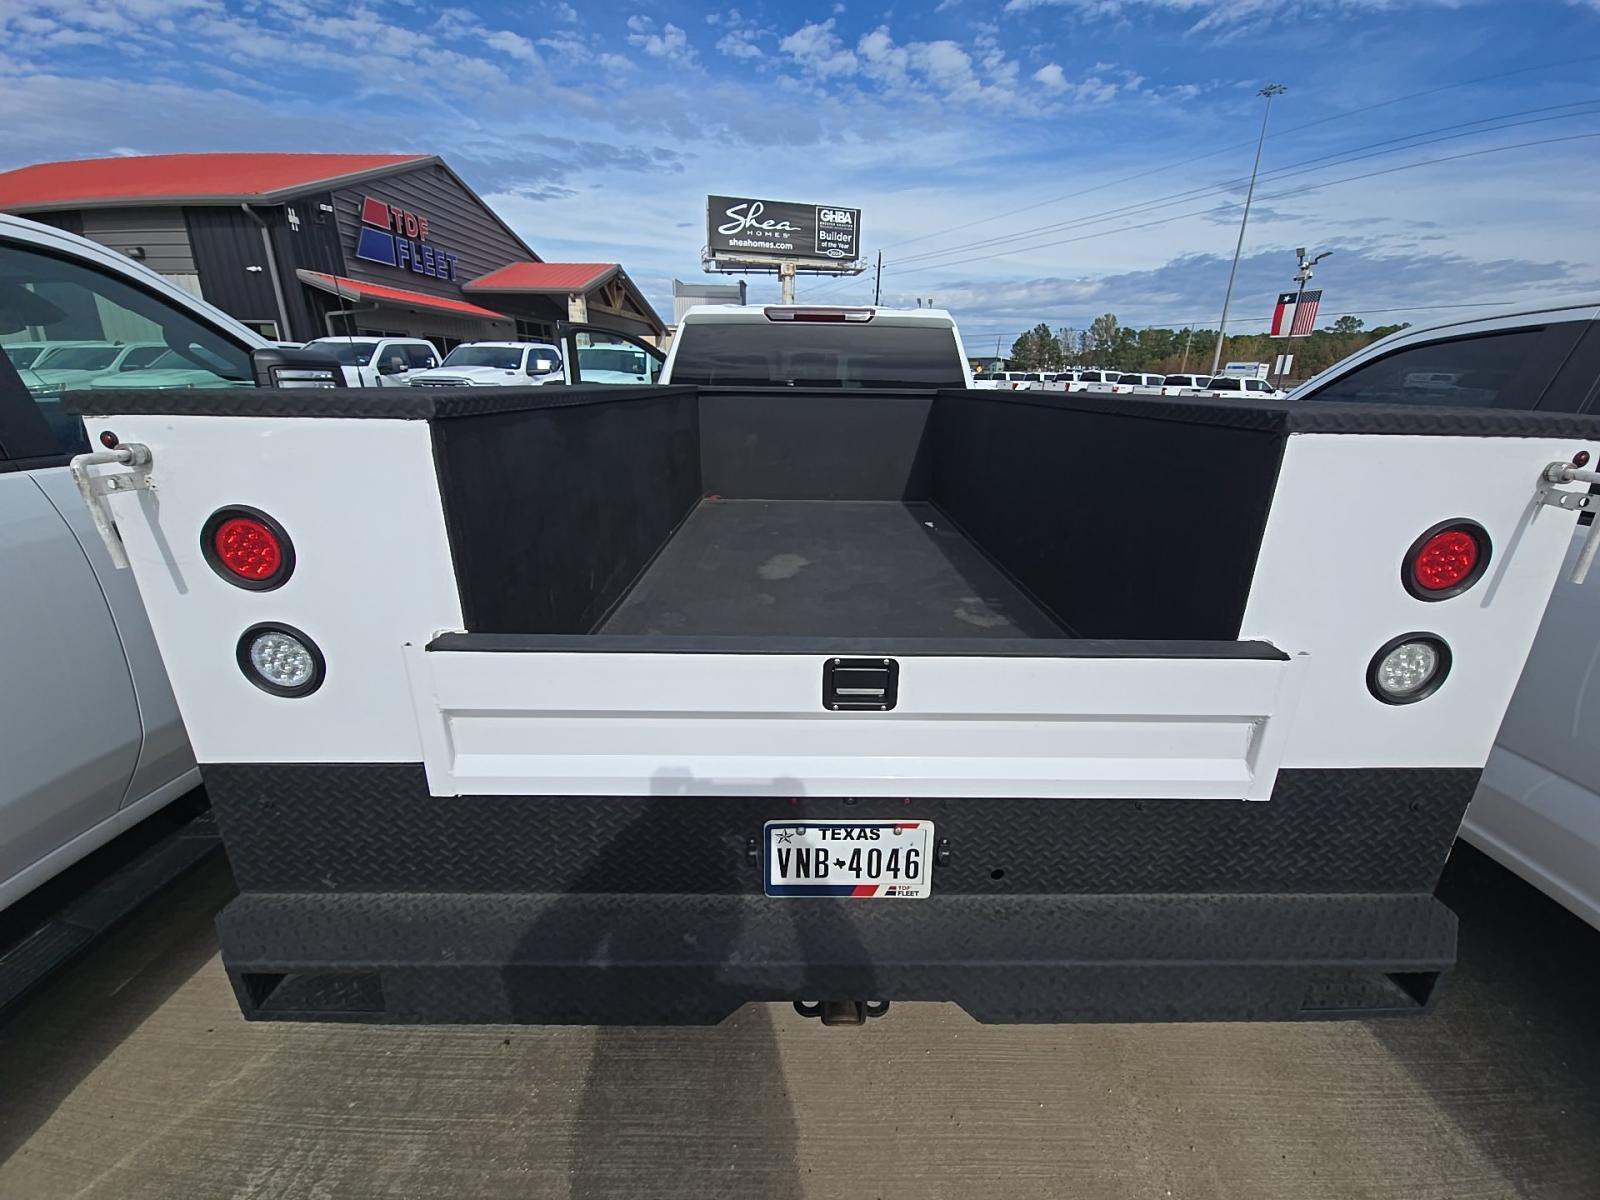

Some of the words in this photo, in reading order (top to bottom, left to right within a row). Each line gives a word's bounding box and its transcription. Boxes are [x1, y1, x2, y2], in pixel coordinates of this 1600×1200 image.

[390, 206, 429, 241] TDF
[718, 202, 801, 235] Shea
[820, 210, 852, 224] GHBA
[728, 238, 793, 250] sheahomes.com
[820, 230, 852, 243] Builder
[396, 236, 457, 281] FLEET
[818, 828, 880, 841] TEXAS
[777, 848, 829, 878] VNB
[848, 848, 920, 879] 4046
